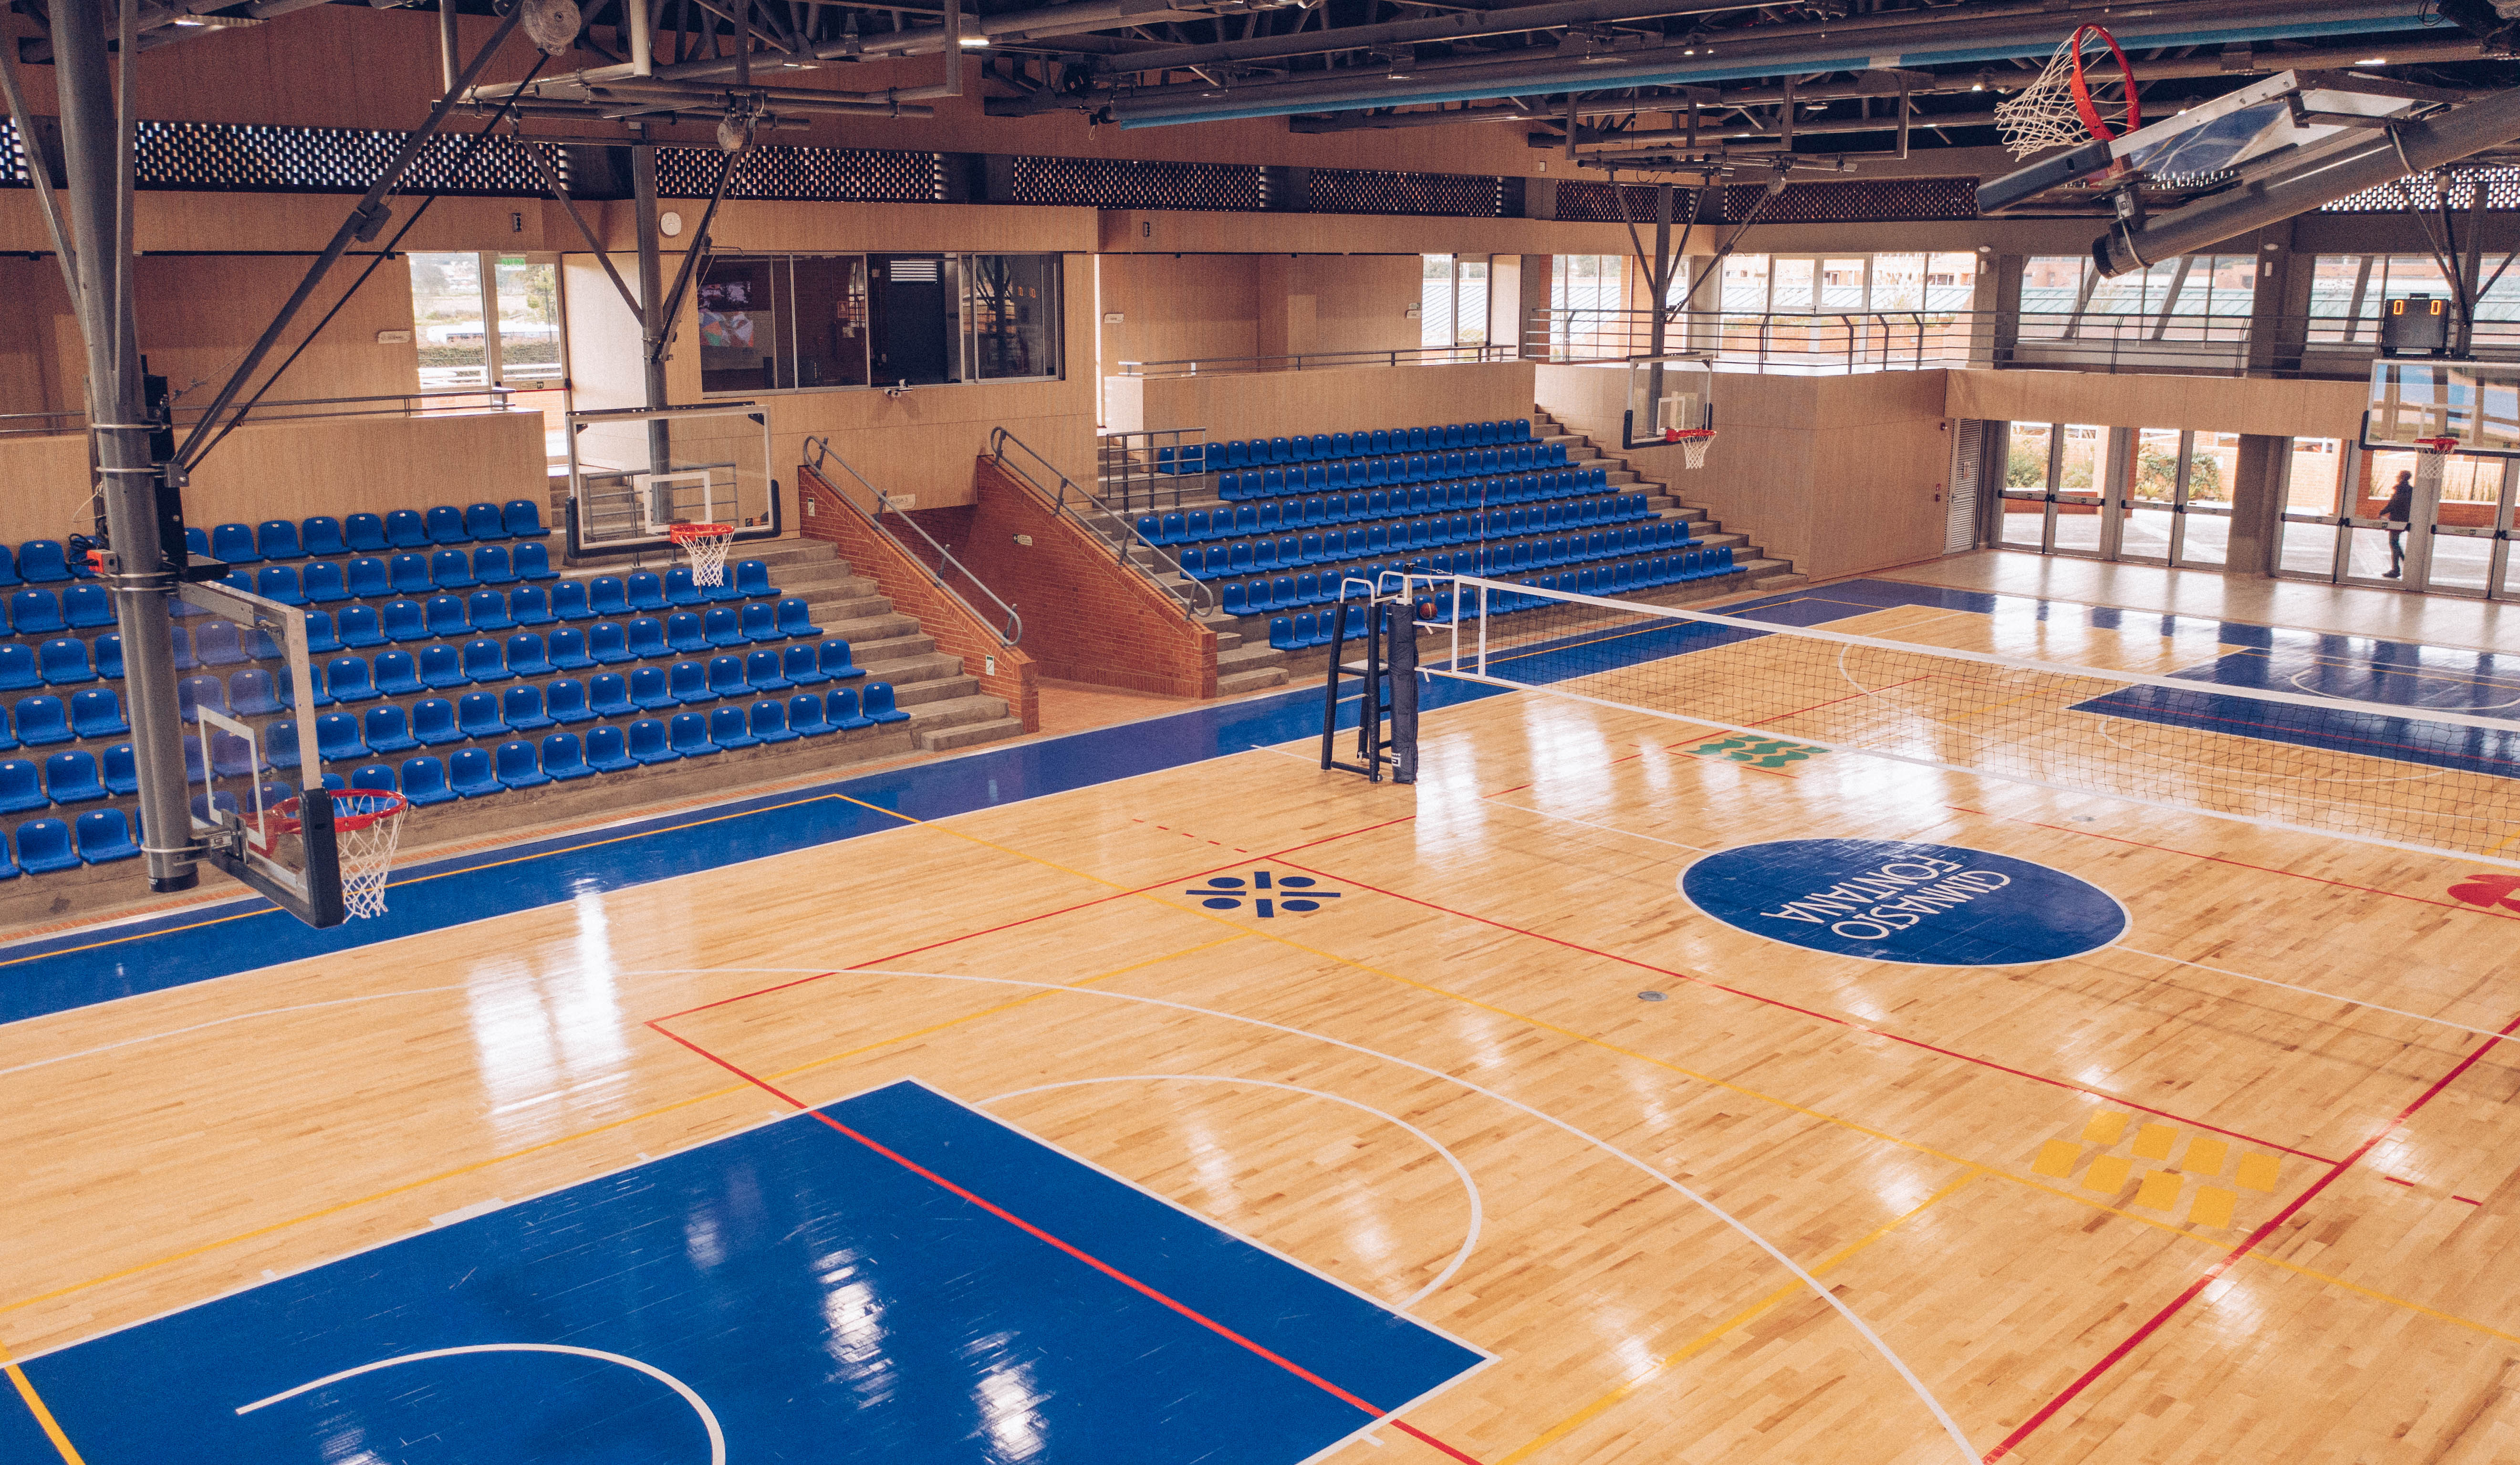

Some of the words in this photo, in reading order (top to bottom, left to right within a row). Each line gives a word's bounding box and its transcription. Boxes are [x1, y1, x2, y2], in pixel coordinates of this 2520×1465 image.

[2393, 300, 2404, 315] 0
[2430, 300, 2441, 315] 0
[1760, 854, 1964, 924] FONTANA
[1831, 870, 2011, 940] GIMNASIO
